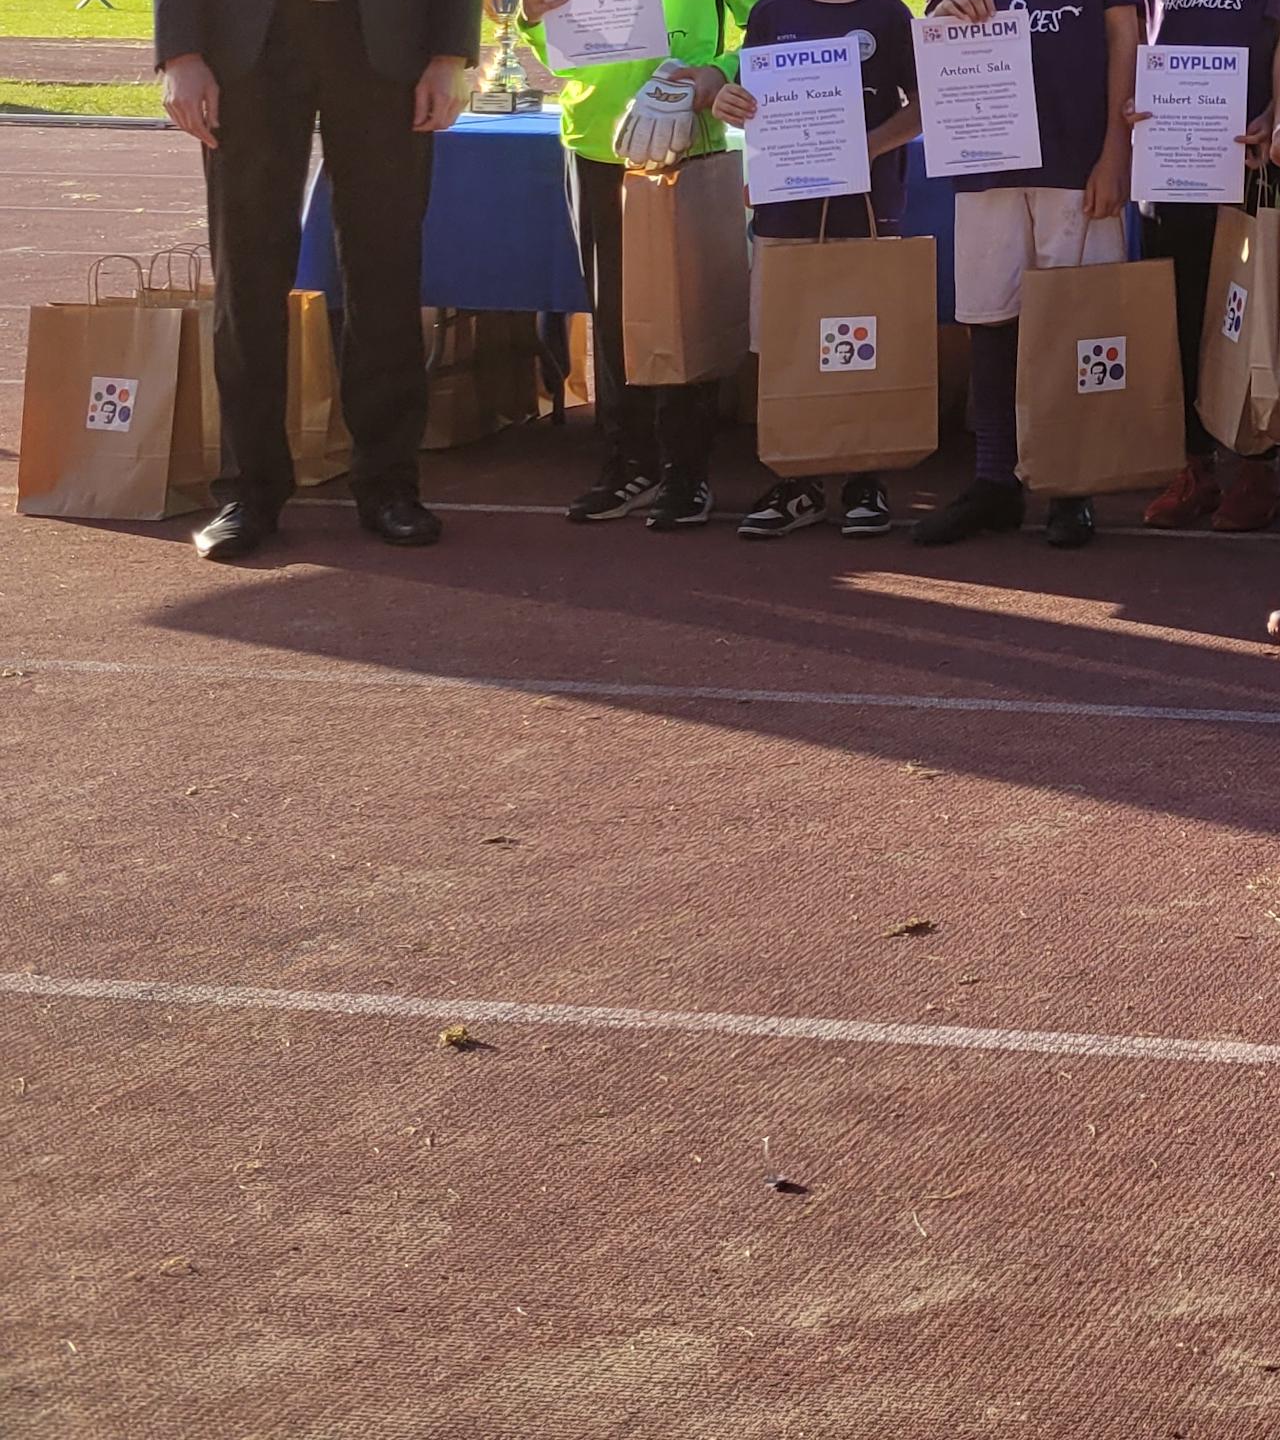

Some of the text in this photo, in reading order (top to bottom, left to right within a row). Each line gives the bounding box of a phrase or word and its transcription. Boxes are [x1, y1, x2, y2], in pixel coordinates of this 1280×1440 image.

[948, 21, 1018, 40] DYPLOM
[775, 48, 848, 68] DYPLOM
[1170, 56, 1236, 70] DYPLOM
[940, 61, 1011, 77] Antoni Sala
[762, 87, 843, 106] Jakub Kozak
[1153, 94, 1227, 105] Hubert Siuta
